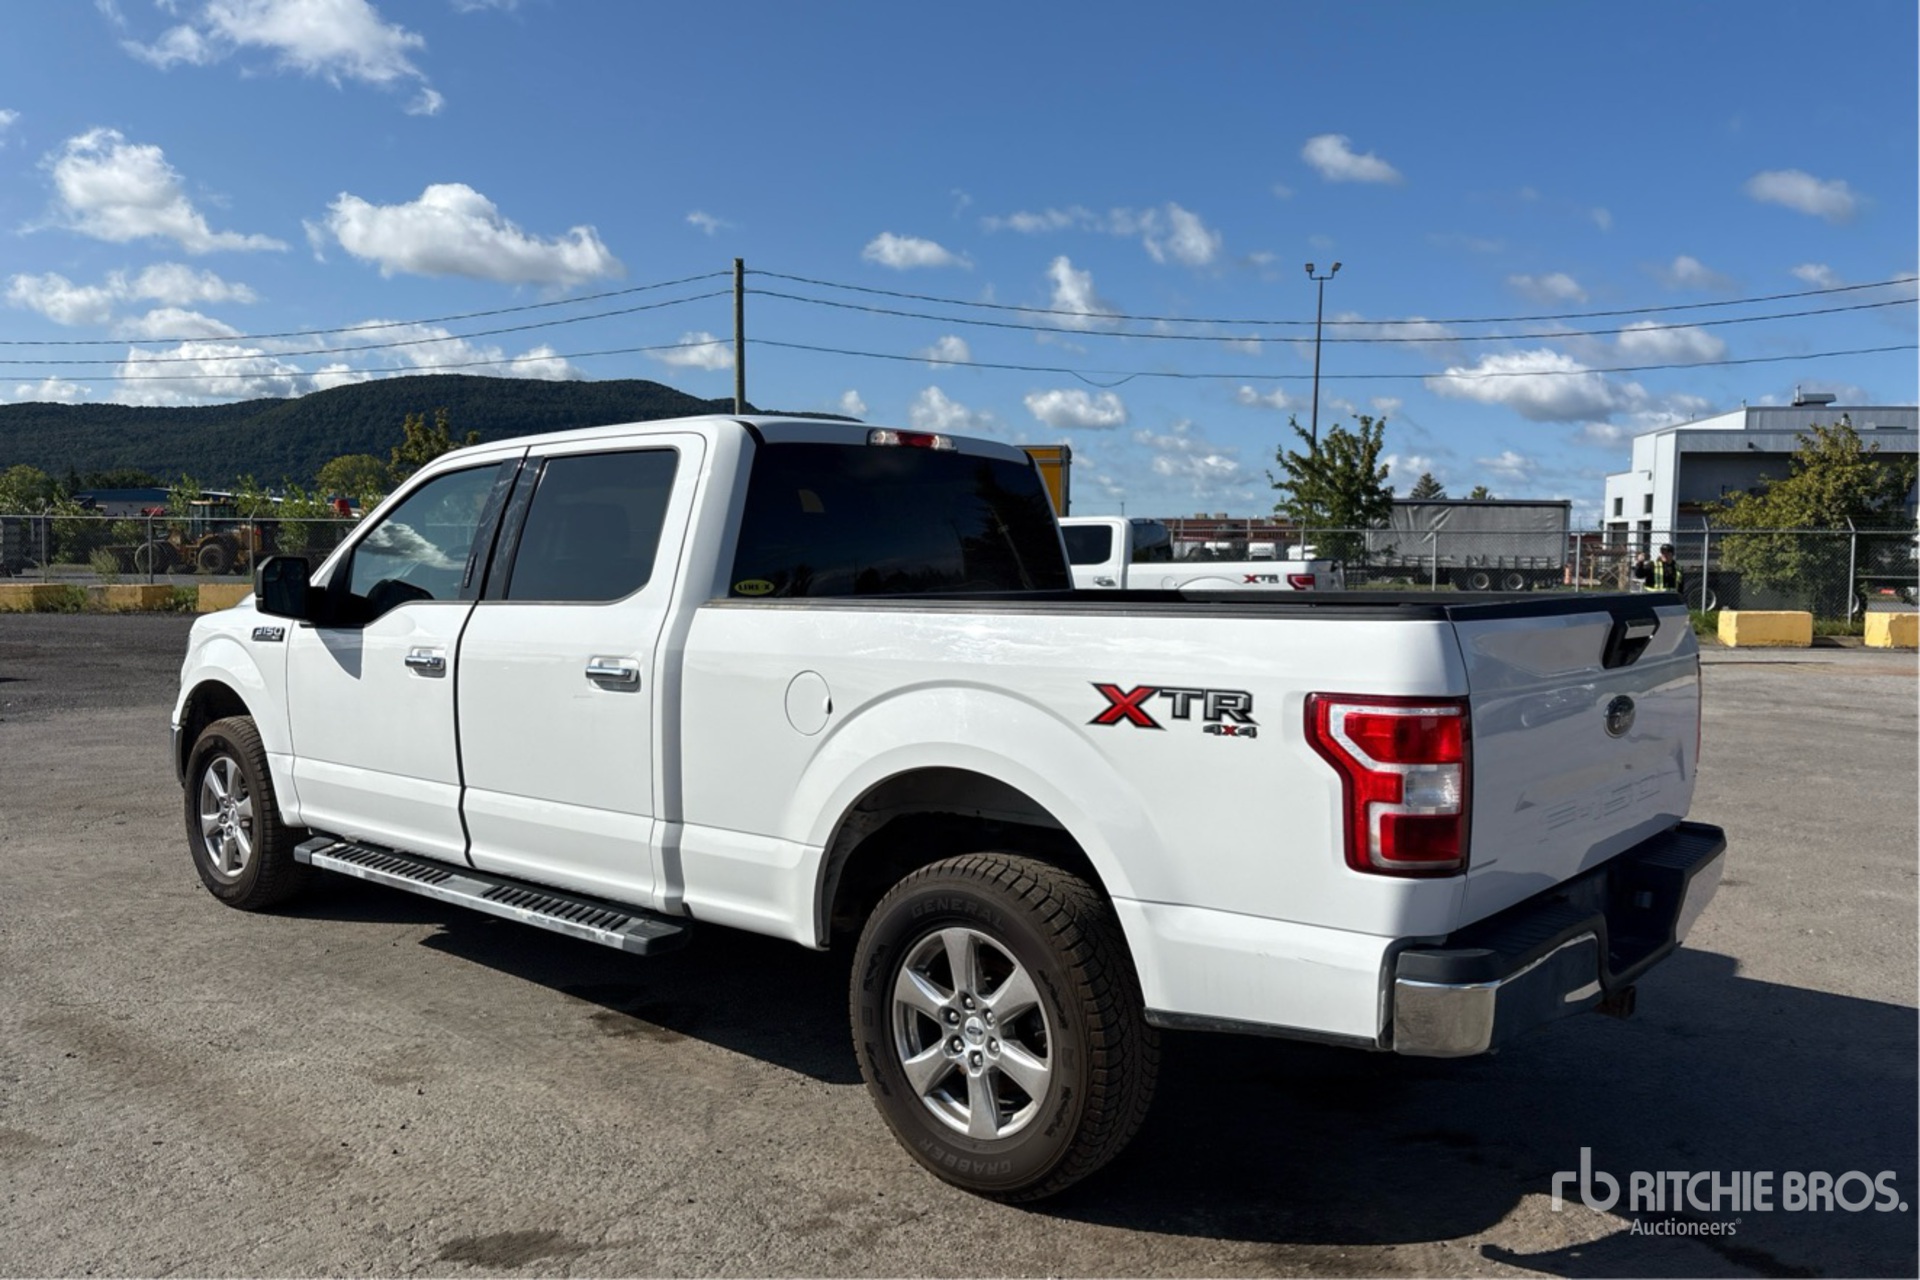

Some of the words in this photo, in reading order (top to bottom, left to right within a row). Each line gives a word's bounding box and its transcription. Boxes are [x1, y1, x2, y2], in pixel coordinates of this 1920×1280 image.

[1086, 682, 1260, 731] XTR
[911, 897, 1005, 932] GENERAL
[919, 1138, 1012, 1176] GRABBER
